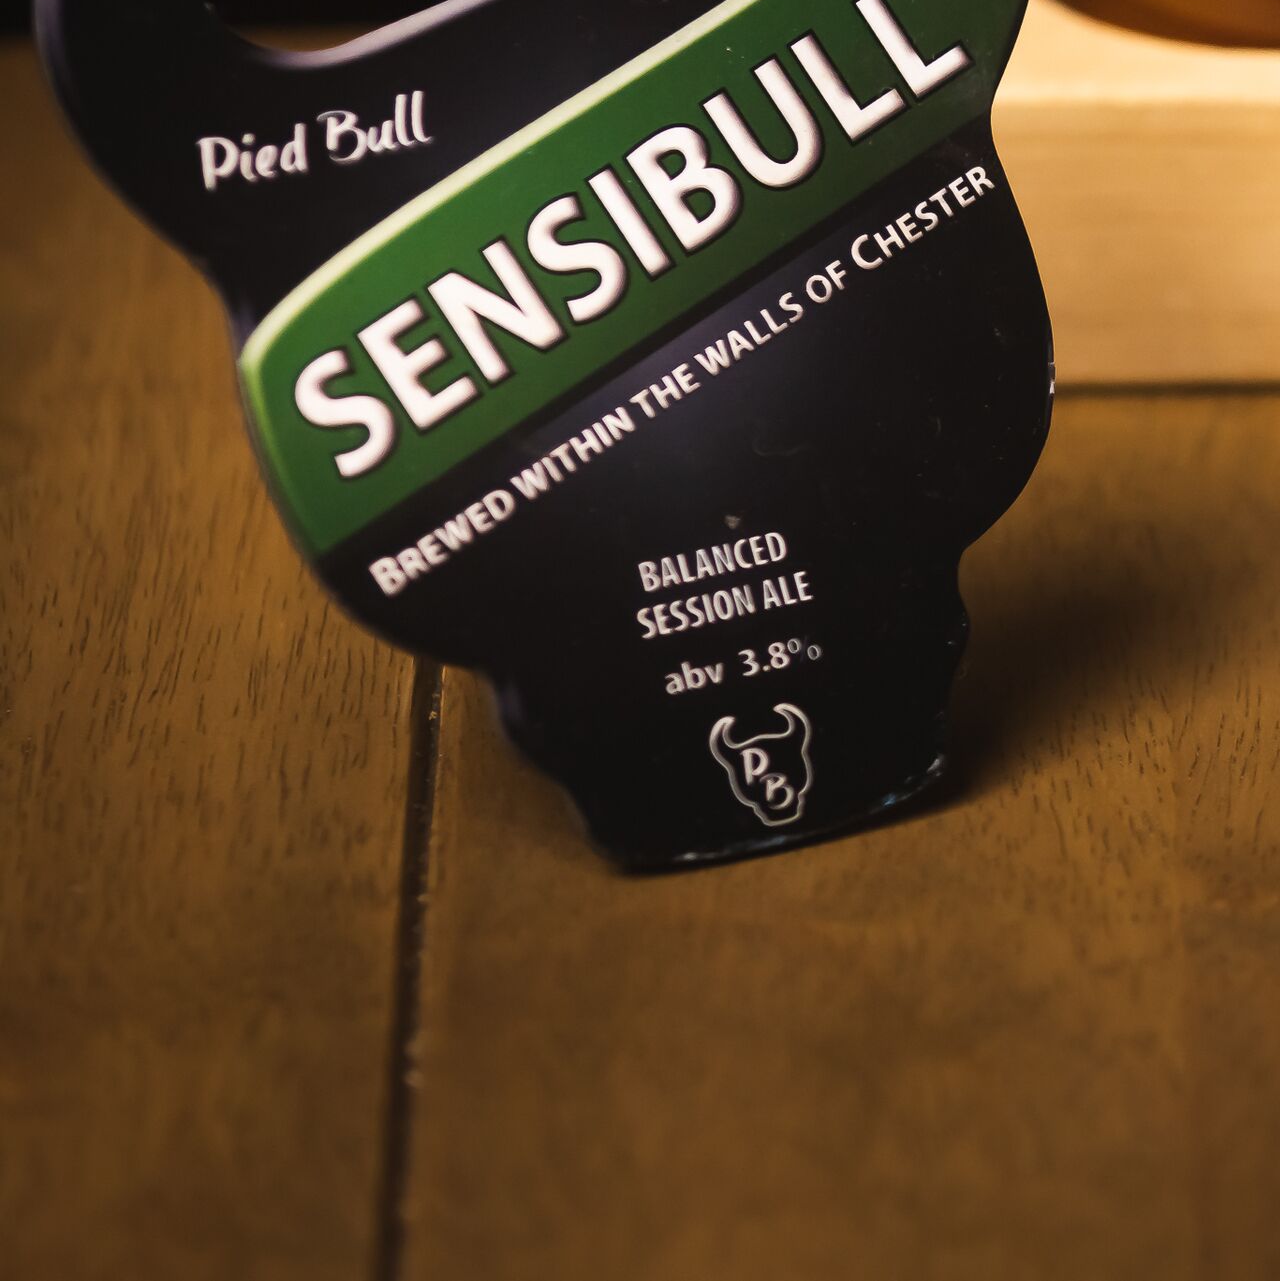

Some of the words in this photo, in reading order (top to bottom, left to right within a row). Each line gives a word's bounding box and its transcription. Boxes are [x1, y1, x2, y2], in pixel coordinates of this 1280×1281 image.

[198, 124, 307, 190] Pied
[324, 90, 430, 164] Bull
[368, 490, 515, 597] BREWED
[510, 406, 637, 501] WITHIN
[630, 364, 700, 419] THE
[694, 292, 804, 376] WALLS
[806, 260, 851, 304] OF
[850, 165, 995, 270] CHESTER
[638, 532, 788, 592] BALANCED
[636, 584, 756, 639] SESSION
[762, 571, 814, 610] ALE
[664, 661, 724, 695] abv
[738, 637, 823, 677] 3.8%
